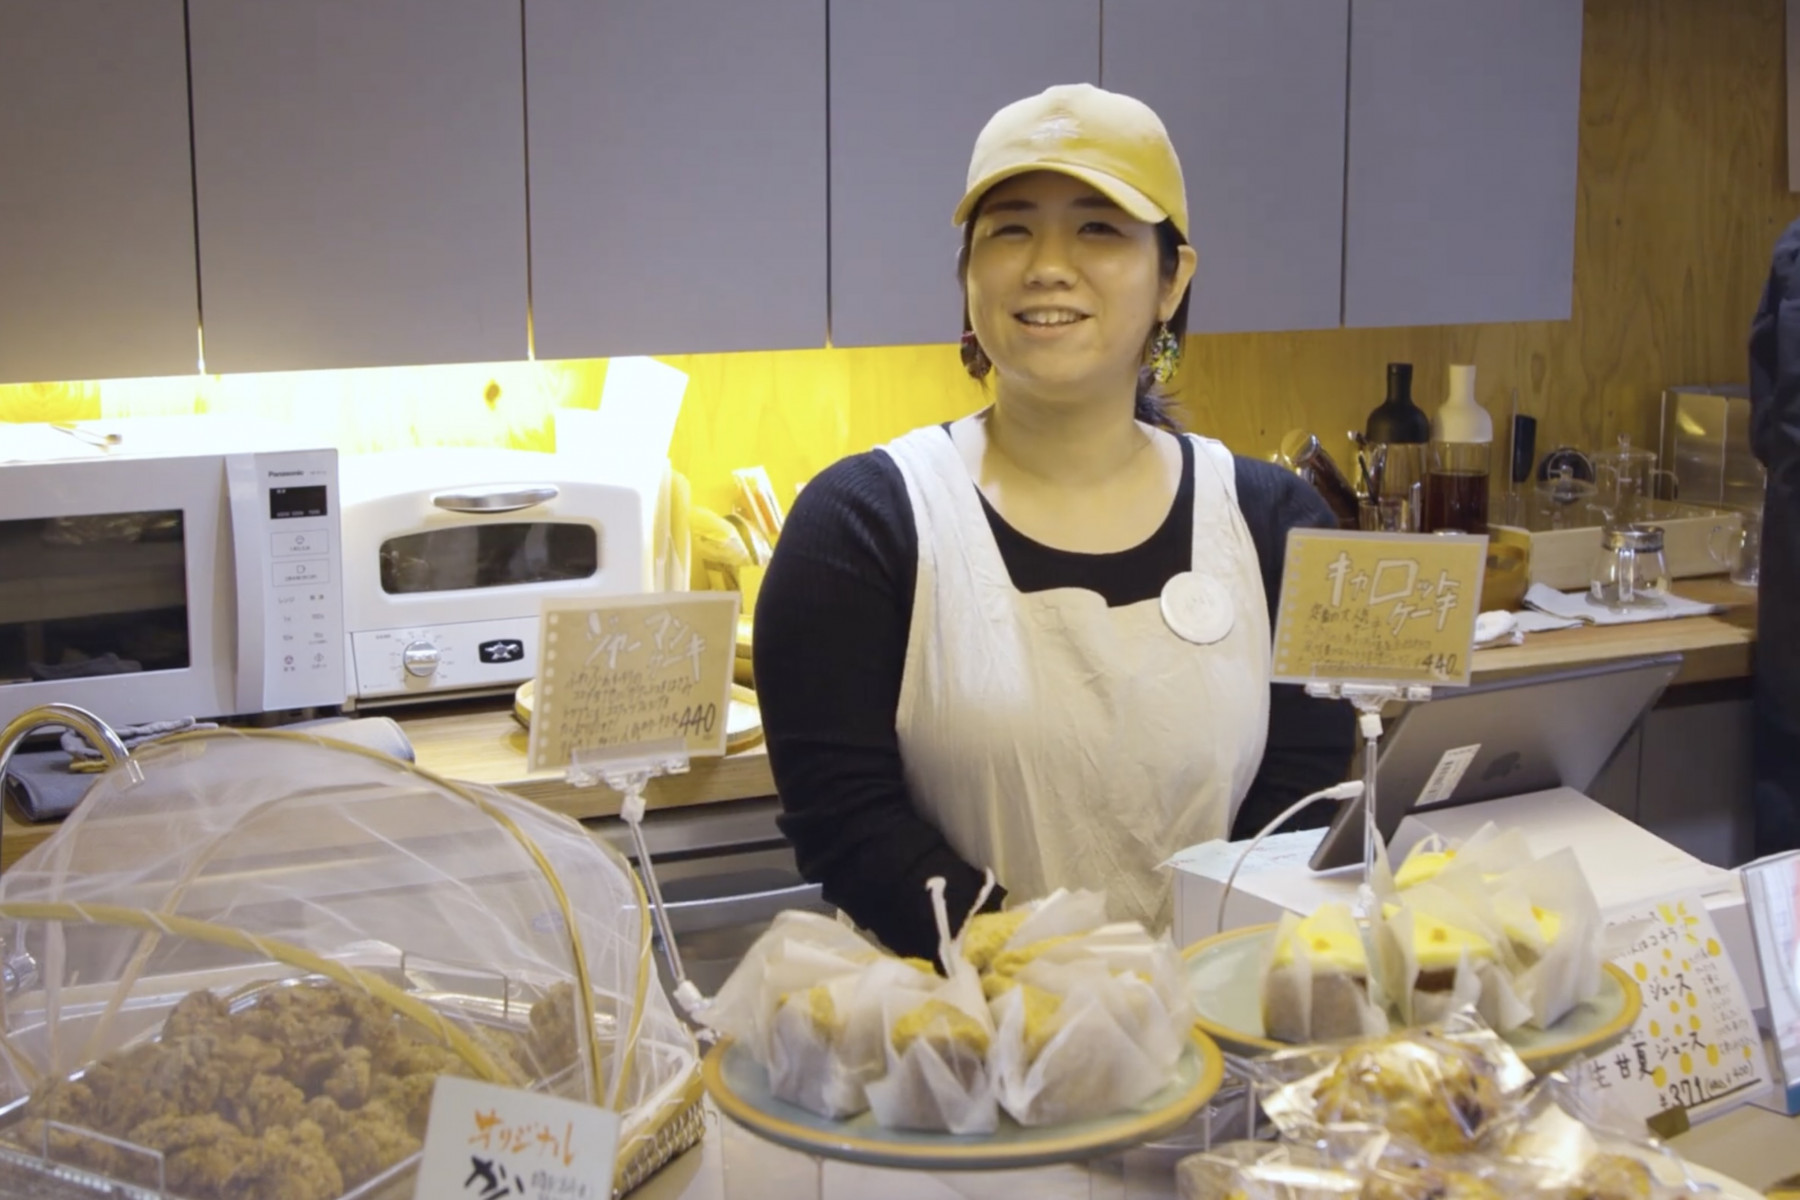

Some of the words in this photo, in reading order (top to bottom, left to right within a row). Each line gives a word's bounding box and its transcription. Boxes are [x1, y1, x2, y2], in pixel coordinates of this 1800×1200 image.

[268, 470, 304, 478] Panasonic
[1325, 551, 1461, 606] キャロット
[1387, 595, 1458, 635] ケーキ
[646, 633, 706, 683] ケーキ
